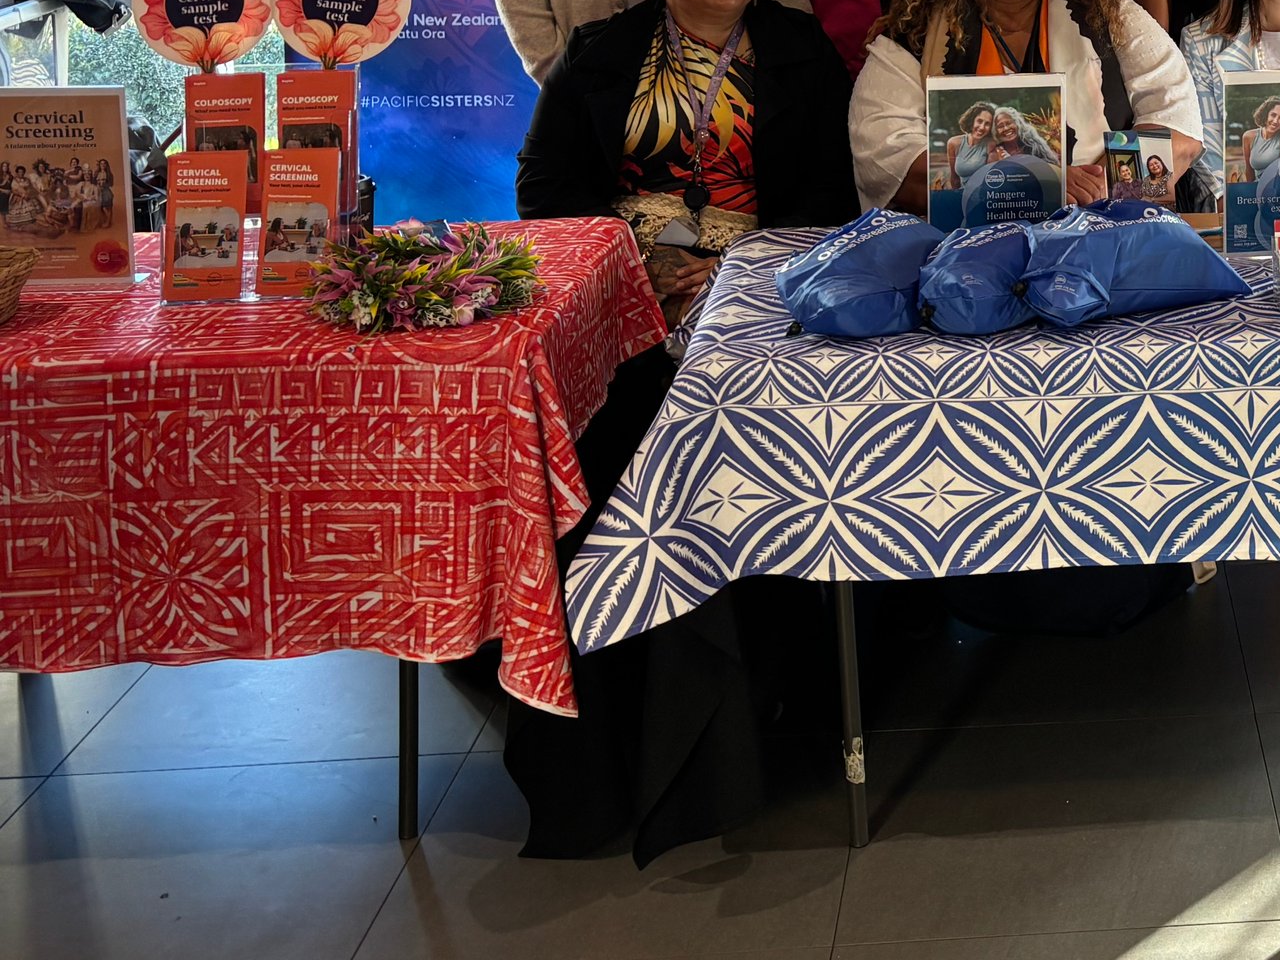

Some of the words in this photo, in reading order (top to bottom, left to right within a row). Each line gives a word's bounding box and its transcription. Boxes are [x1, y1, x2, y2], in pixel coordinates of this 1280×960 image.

[181, 0, 229, 15] sample
[316, 0, 363, 14] sample
[193, 14, 218, 25] test
[325, 11, 349, 22] test
[413, 13, 447, 26] New
[422, 29, 446, 39] Ora
[194, 97, 253, 107] COLPOSCOPY
[281, 95, 338, 105] COLPOSCOPY
[360, 94, 516, 108] #PACIFICSISTERSNZ
[13, 110, 84, 124] Cervical
[5, 125, 95, 141] Screening
[176, 169, 221, 177] CERVICAL
[270, 164, 312, 172] CERVICAL
[176, 178, 228, 186] SCREENING
[269, 173, 318, 182] SCREENING
[986, 191, 1026, 201] Mangere
[1237, 196, 1265, 205] Breast
[986, 200, 1039, 210] Community
[986, 210, 1017, 220] Health
[1018, 209, 1049, 219] Centre
